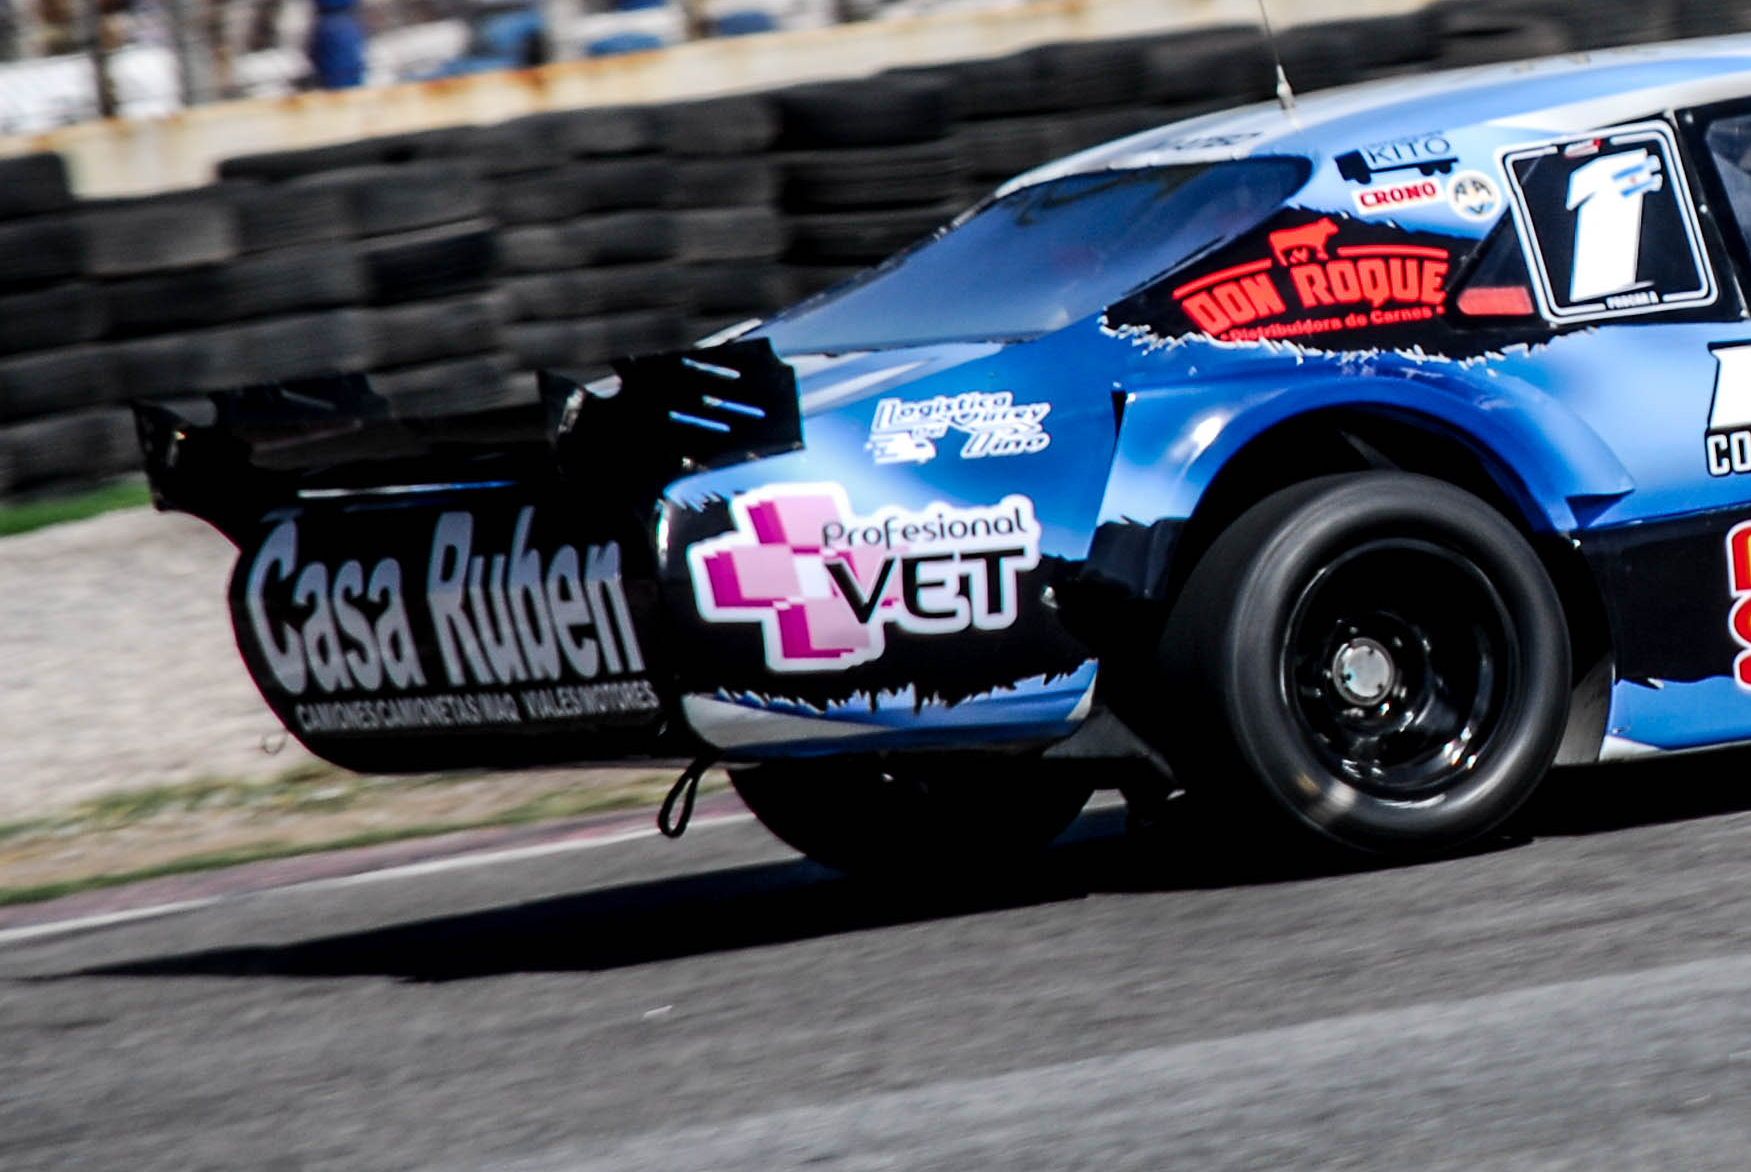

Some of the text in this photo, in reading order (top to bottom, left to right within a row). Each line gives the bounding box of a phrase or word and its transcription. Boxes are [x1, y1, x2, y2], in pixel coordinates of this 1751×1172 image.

[1364, 136, 1450, 164] KITO
[1359, 181, 1438, 209] CRONO
[1566, 148, 1662, 303] 1
[1180, 256, 1449, 338] DON ROQUE
[1228, 306, 1433, 343] Distribuidora de Carnes
[821, 506, 1028, 550] Profesional
[246, 505, 647, 695] Casa Ruben
[822, 546, 1027, 626] VET
